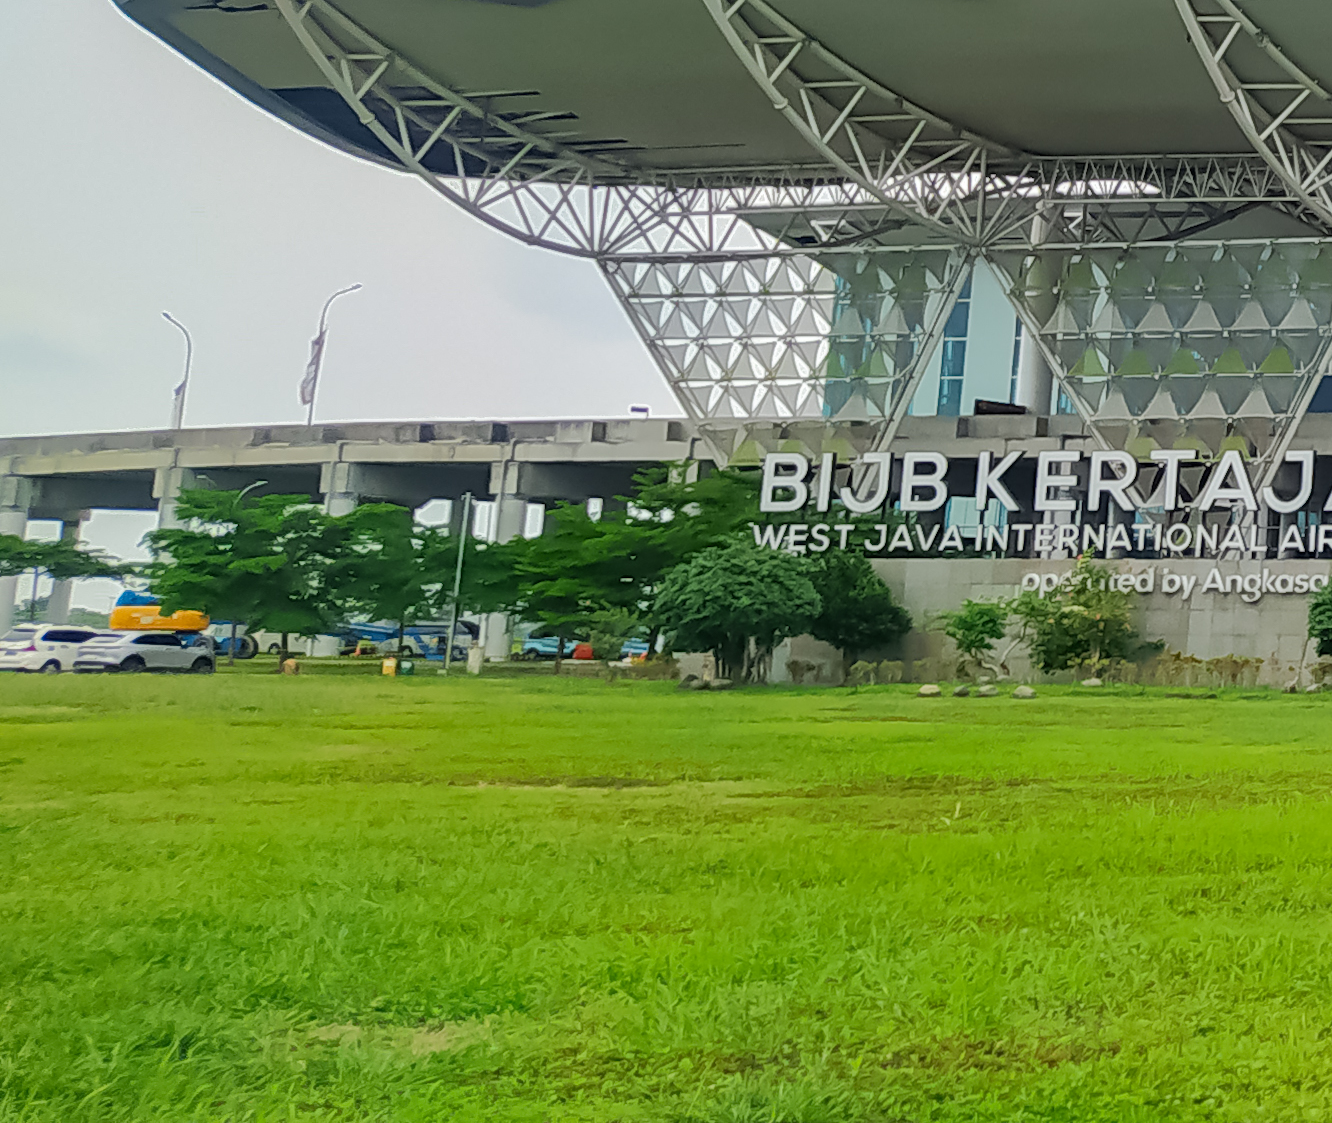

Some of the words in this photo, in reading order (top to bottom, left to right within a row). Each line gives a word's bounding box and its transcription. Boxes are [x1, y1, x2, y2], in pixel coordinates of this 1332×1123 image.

[760, 451, 948, 514] BIJB
[749, 522, 855, 553] WEST
[864, 524, 964, 553] JAVA
[975, 523, 1268, 553] INTERNATIONAL
[1162, 567, 1196, 601] by
[1201, 567, 1329, 603] Angkasa
